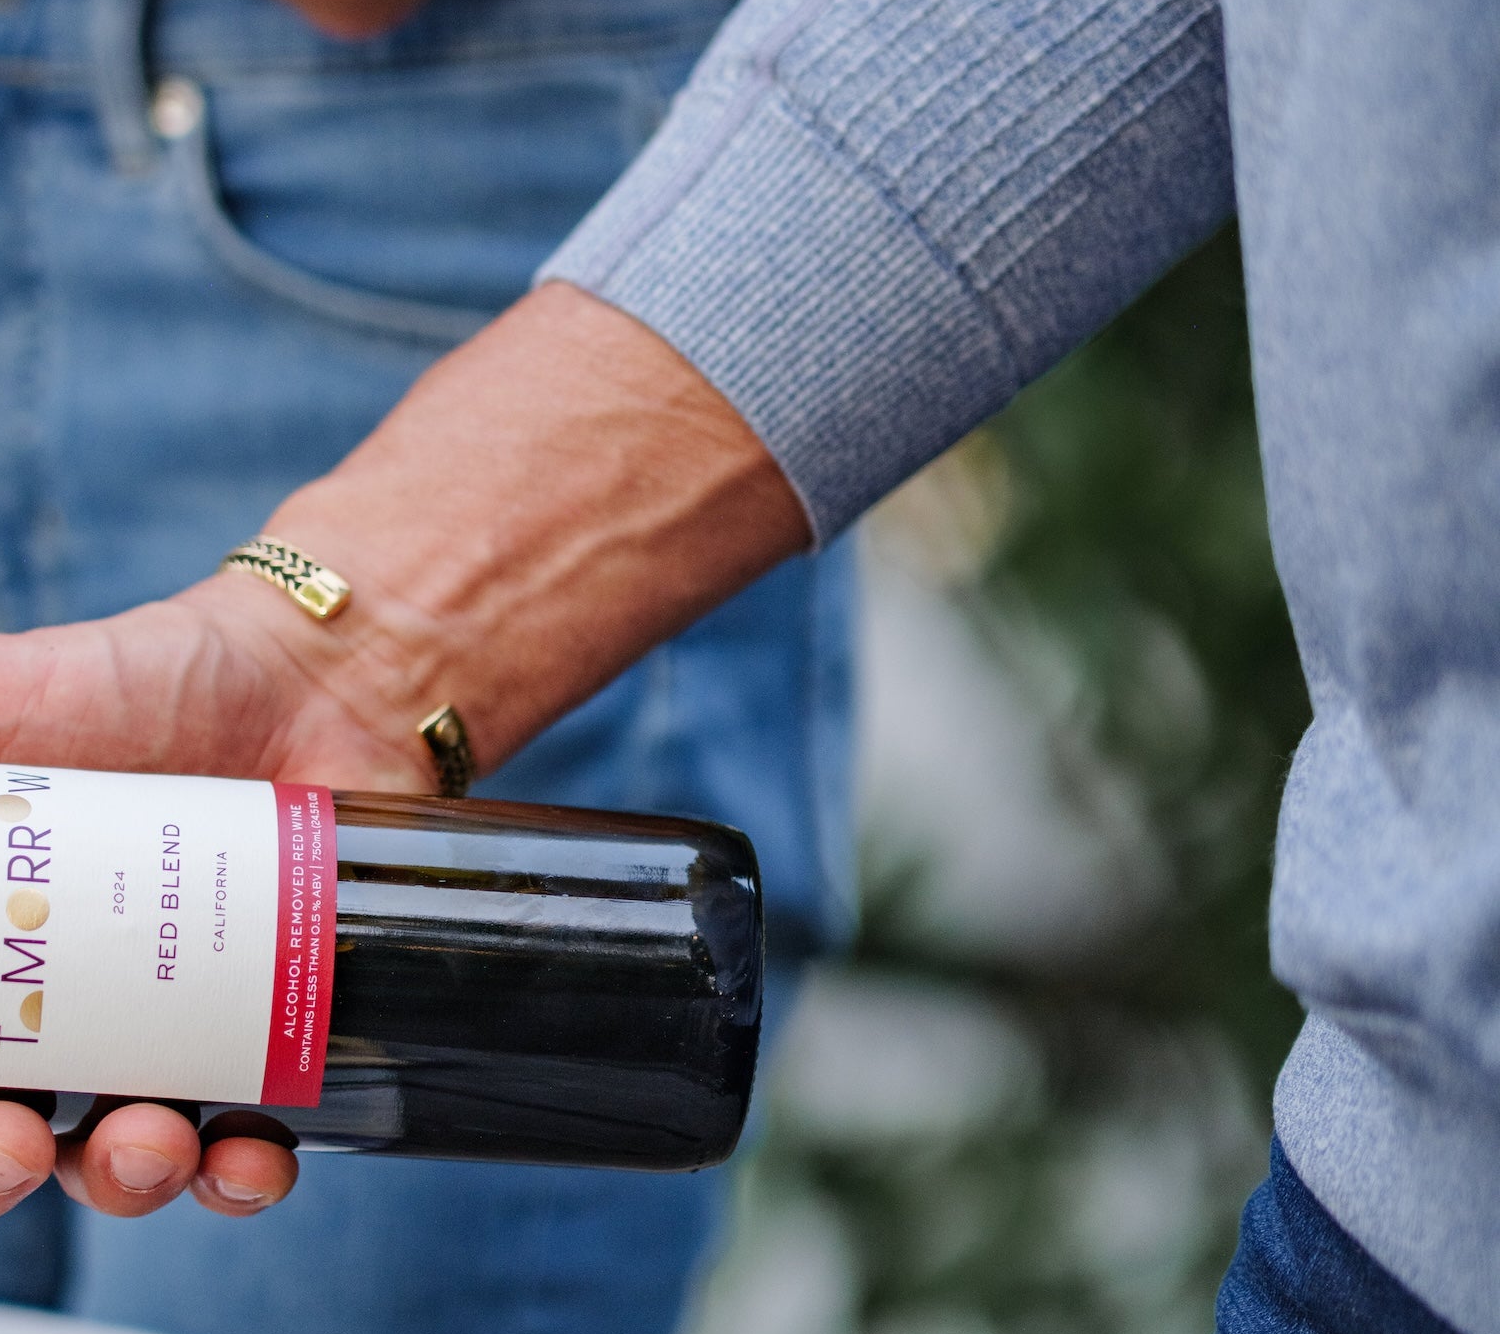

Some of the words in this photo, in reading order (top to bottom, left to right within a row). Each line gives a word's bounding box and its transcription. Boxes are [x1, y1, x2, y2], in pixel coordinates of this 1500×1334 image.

[290, 804, 304, 831] WINE
[161, 823, 181, 910] BLEND
[292, 834, 304, 861] RED
[311, 829, 322, 861] 750mL
[113, 870, 125, 915] 2024
[213, 851, 228, 952] CALIFORNIA
[290, 866, 304, 948] REMOVED
[312, 873, 322, 898] ABV
[157, 922, 178, 980] RED
[308, 938, 320, 973] THAN
[283, 954, 302, 1038] ALCOHOL
[305, 974, 318, 1008] LESS
[299, 1010, 315, 1072] CONTAINS
